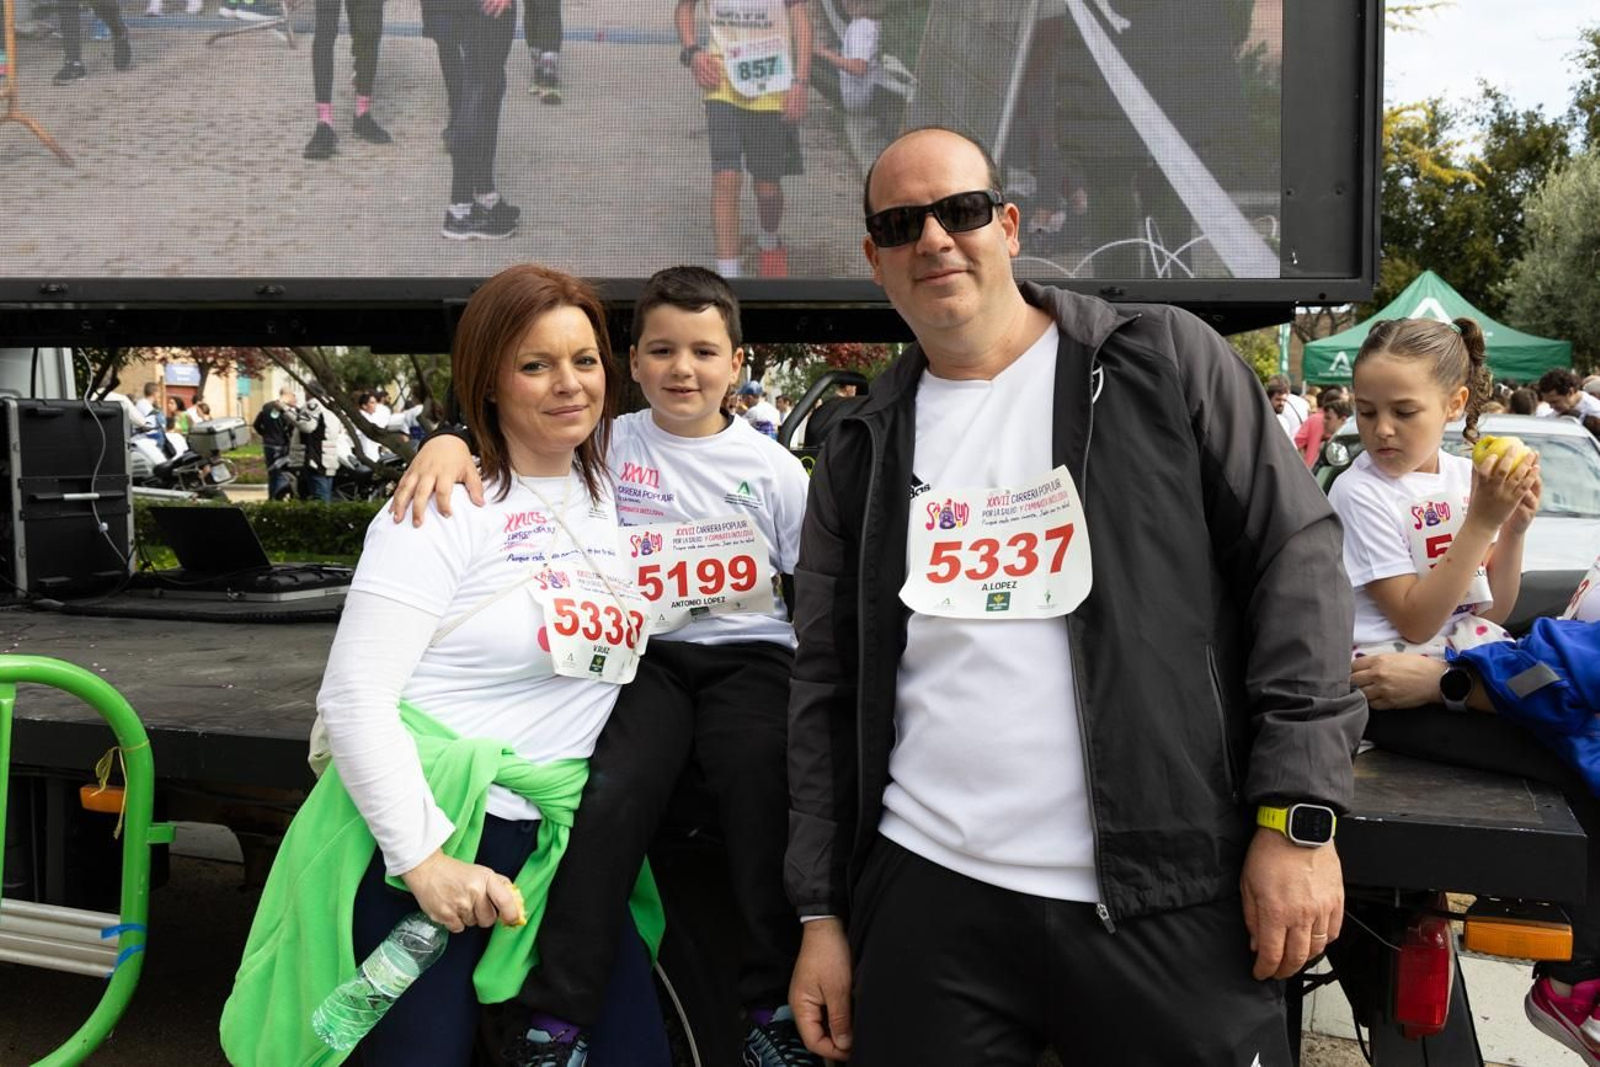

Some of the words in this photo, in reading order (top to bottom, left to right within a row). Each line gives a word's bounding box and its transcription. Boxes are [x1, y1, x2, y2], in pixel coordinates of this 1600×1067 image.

[738, 55, 778, 80] 857
[987, 495, 1010, 507] XXVII
[1011, 490, 1039, 504] CARRERA
[926, 522, 1075, 584] 5337
[637, 555, 758, 602] 5199
[671, 599, 702, 608] ANTONIO
[703, 596, 726, 606] LOPEZ
